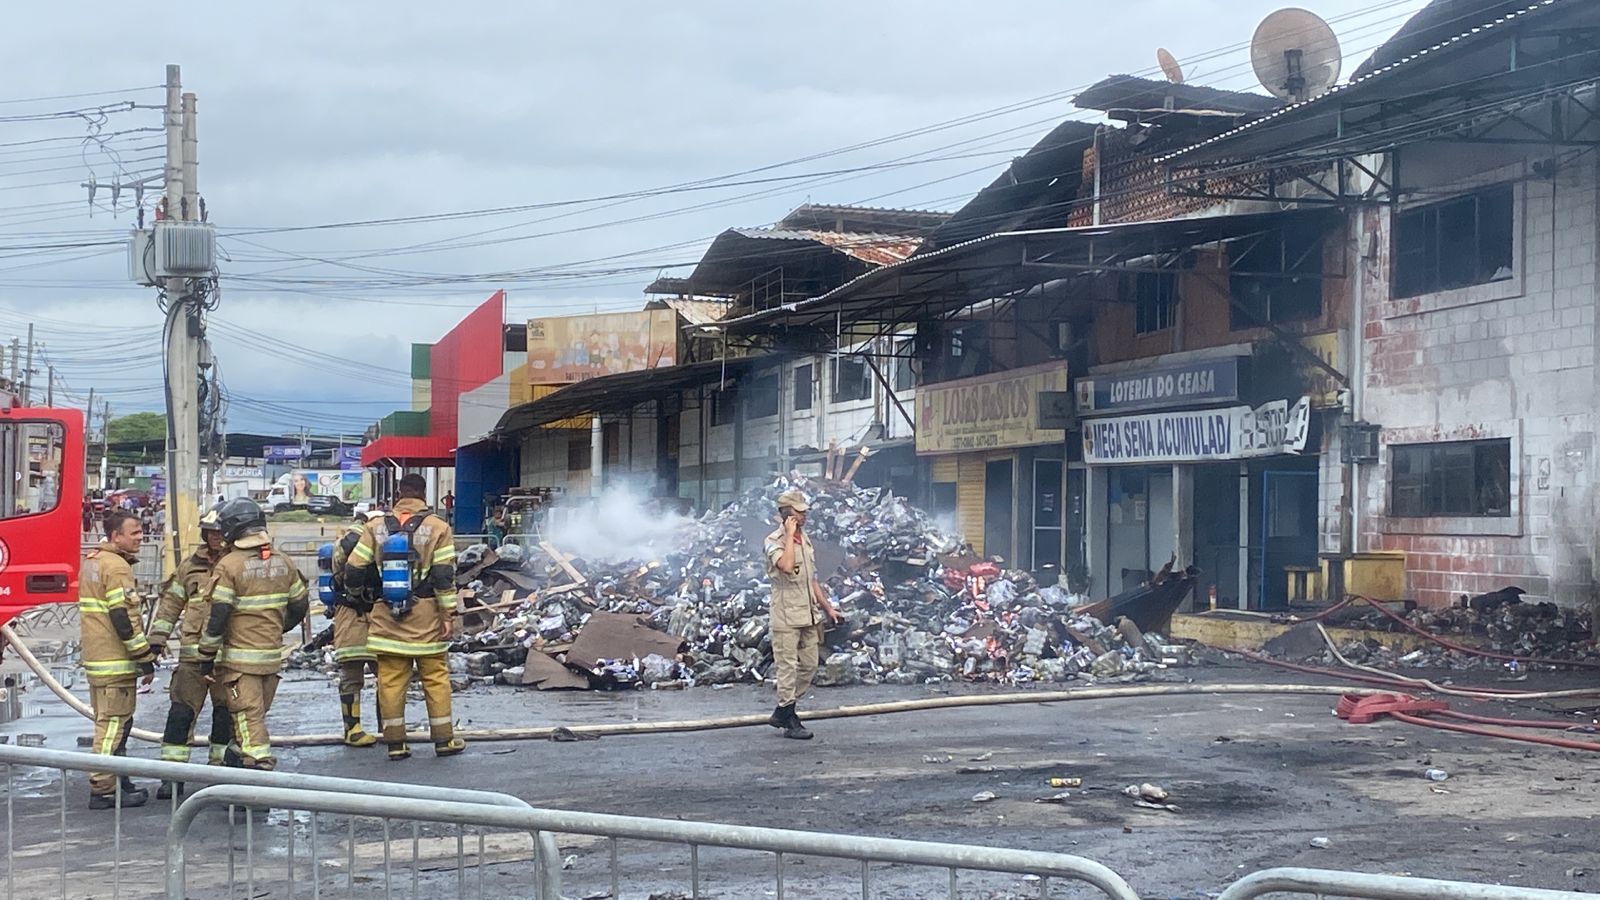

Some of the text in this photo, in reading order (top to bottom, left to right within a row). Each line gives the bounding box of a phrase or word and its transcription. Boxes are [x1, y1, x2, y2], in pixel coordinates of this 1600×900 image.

[1110, 370, 1215, 403] LOTERIA DO CEASA
[1093, 422, 1122, 458] MEGA
[1123, 419, 1155, 457] SENA
[1157, 412, 1231, 456] ACUMULAD
